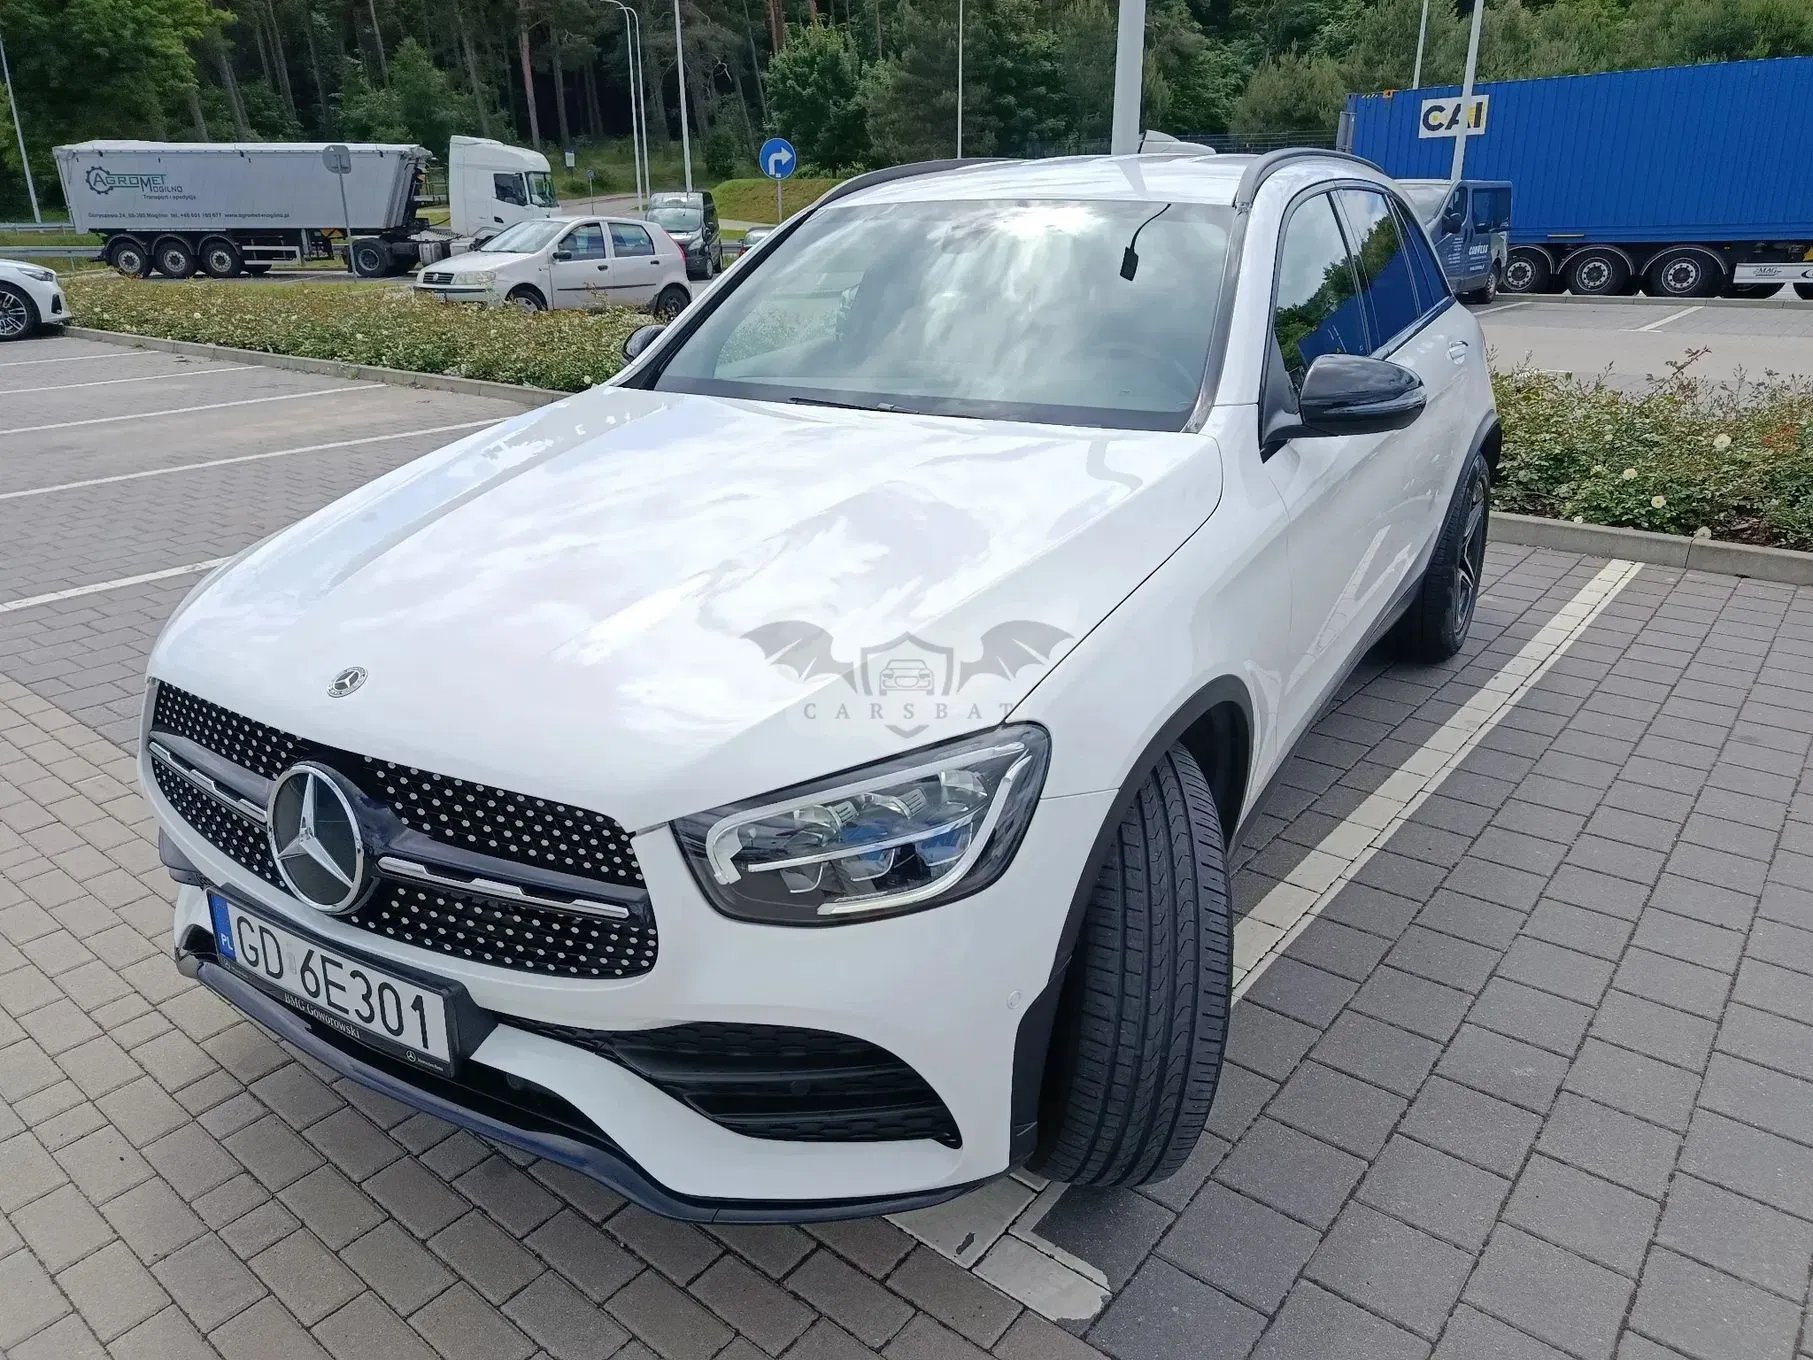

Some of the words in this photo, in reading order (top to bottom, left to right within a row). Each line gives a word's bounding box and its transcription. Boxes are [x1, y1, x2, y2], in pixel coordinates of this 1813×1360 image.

[1422, 102, 1484, 131] CAI
[93, 172, 166, 192] AGROMET
[221, 932, 233, 951] PL
[236, 915, 284, 979] GD
[300, 949, 429, 1050] 6E301
[284, 993, 306, 1011] BMG
[306, 1005, 361, 1039] Goworowski
